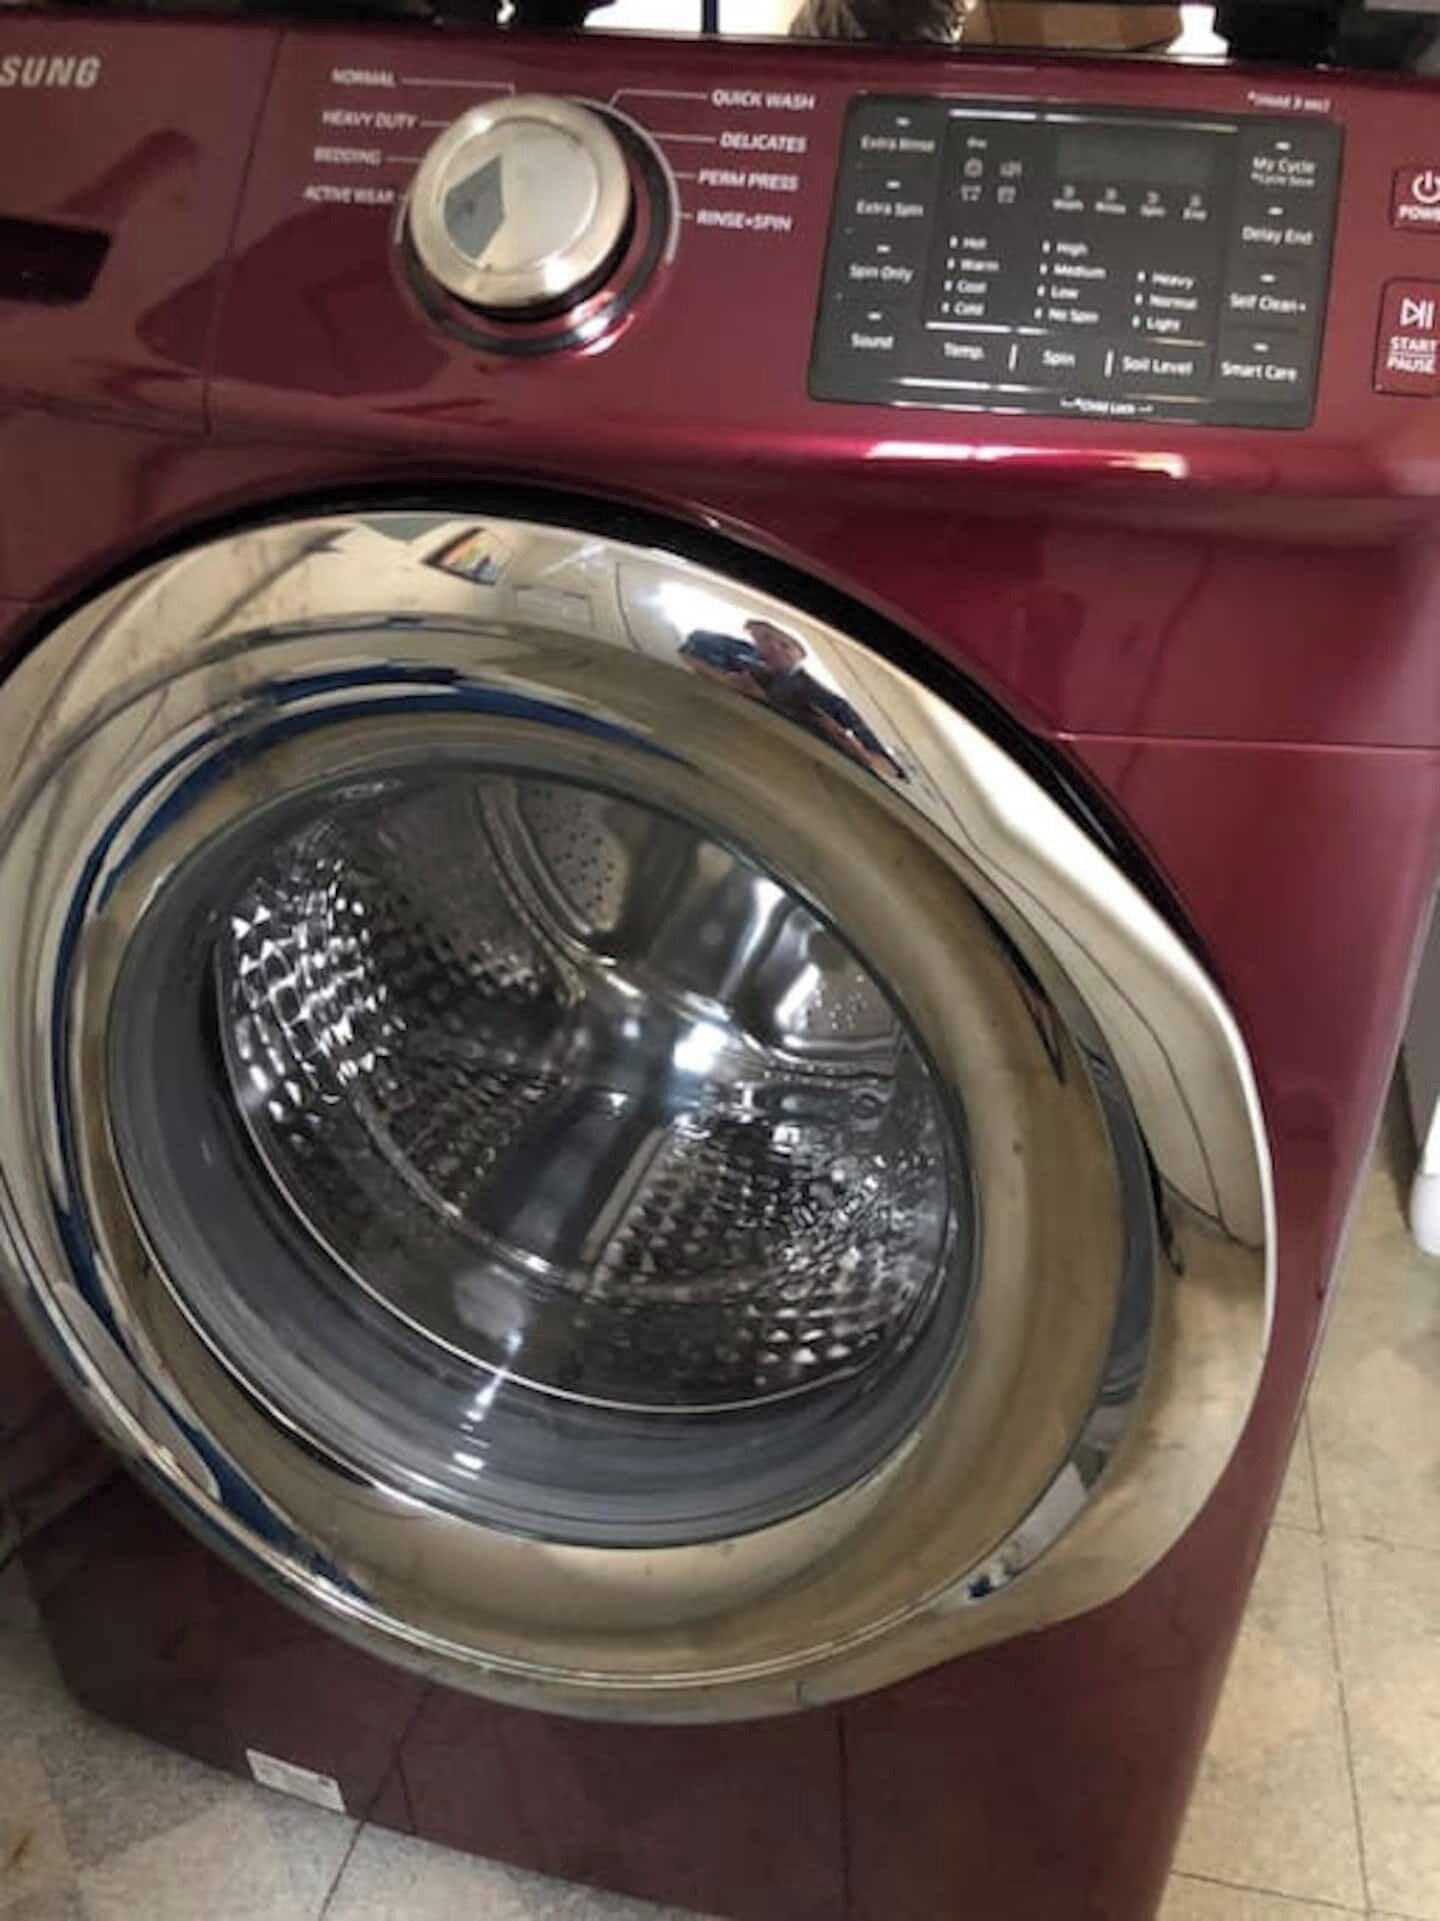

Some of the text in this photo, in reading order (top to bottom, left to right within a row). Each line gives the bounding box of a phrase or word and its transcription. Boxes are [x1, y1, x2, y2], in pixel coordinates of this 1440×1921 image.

[0, 56, 101, 89] SUNG
[331, 68, 396, 89] NORMAL
[711, 88, 815, 110] QUICK WASH
[322, 109, 418, 129] HEAVY DUTY
[720, 131, 807, 154] DELICATES
[861, 135, 898, 151] Extra
[313, 147, 382, 166] BEDDING
[1253, 156, 1317, 175] My Cycle
[699, 169, 799, 191] PERM PRESS
[304, 185, 395, 205] ACTIVE WEAR
[856, 200, 894, 216] Extra
[963, 237, 988, 250] Hot
[1242, 226, 1314, 246] Delay End
[849, 264, 914, 283] Spin Only
[1152, 271, 1195, 290] Heavy
[1230, 291, 1257, 309] Self
[1048, 306, 1068, 322] No
[851, 333, 894, 350] Sound
[1390, 336, 1438, 352] START
[1043, 350, 1076, 367] Spin
[1122, 354, 1194, 375] Soil Level
[1387, 356, 1437, 374] PAUSE
[1220, 361, 1298, 382] Smart Care
